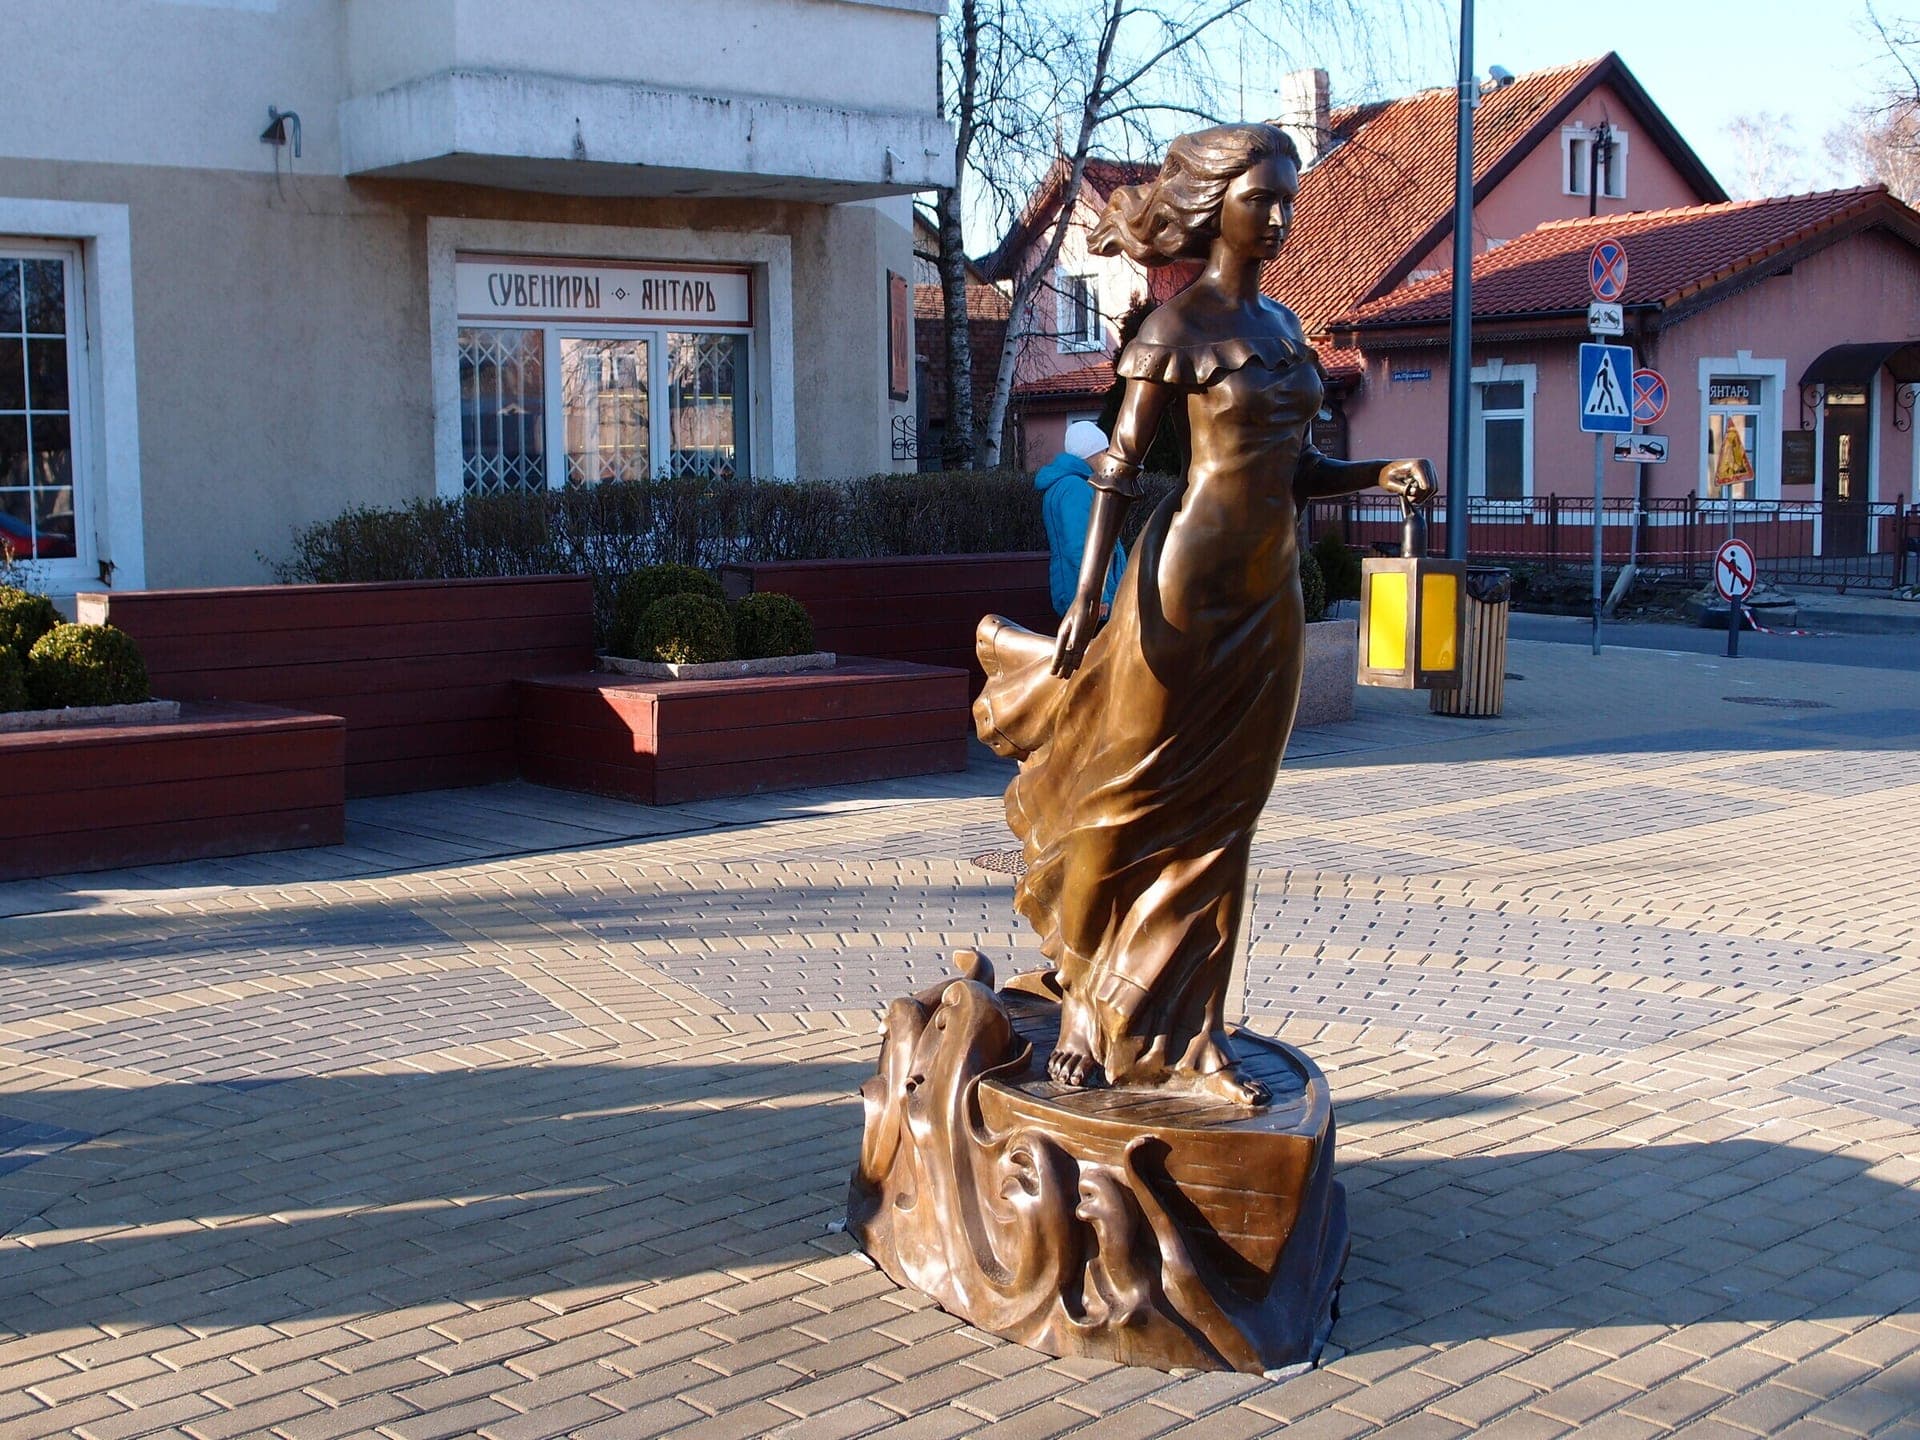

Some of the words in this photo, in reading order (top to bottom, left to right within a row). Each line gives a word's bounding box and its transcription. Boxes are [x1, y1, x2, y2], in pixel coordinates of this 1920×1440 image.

[487, 272, 601, 309] СУВЕНИРЫ
[642, 278, 717, 313] ЯНТАРЬ
[1709, 384, 1750, 398] ЯНТАРЬ
